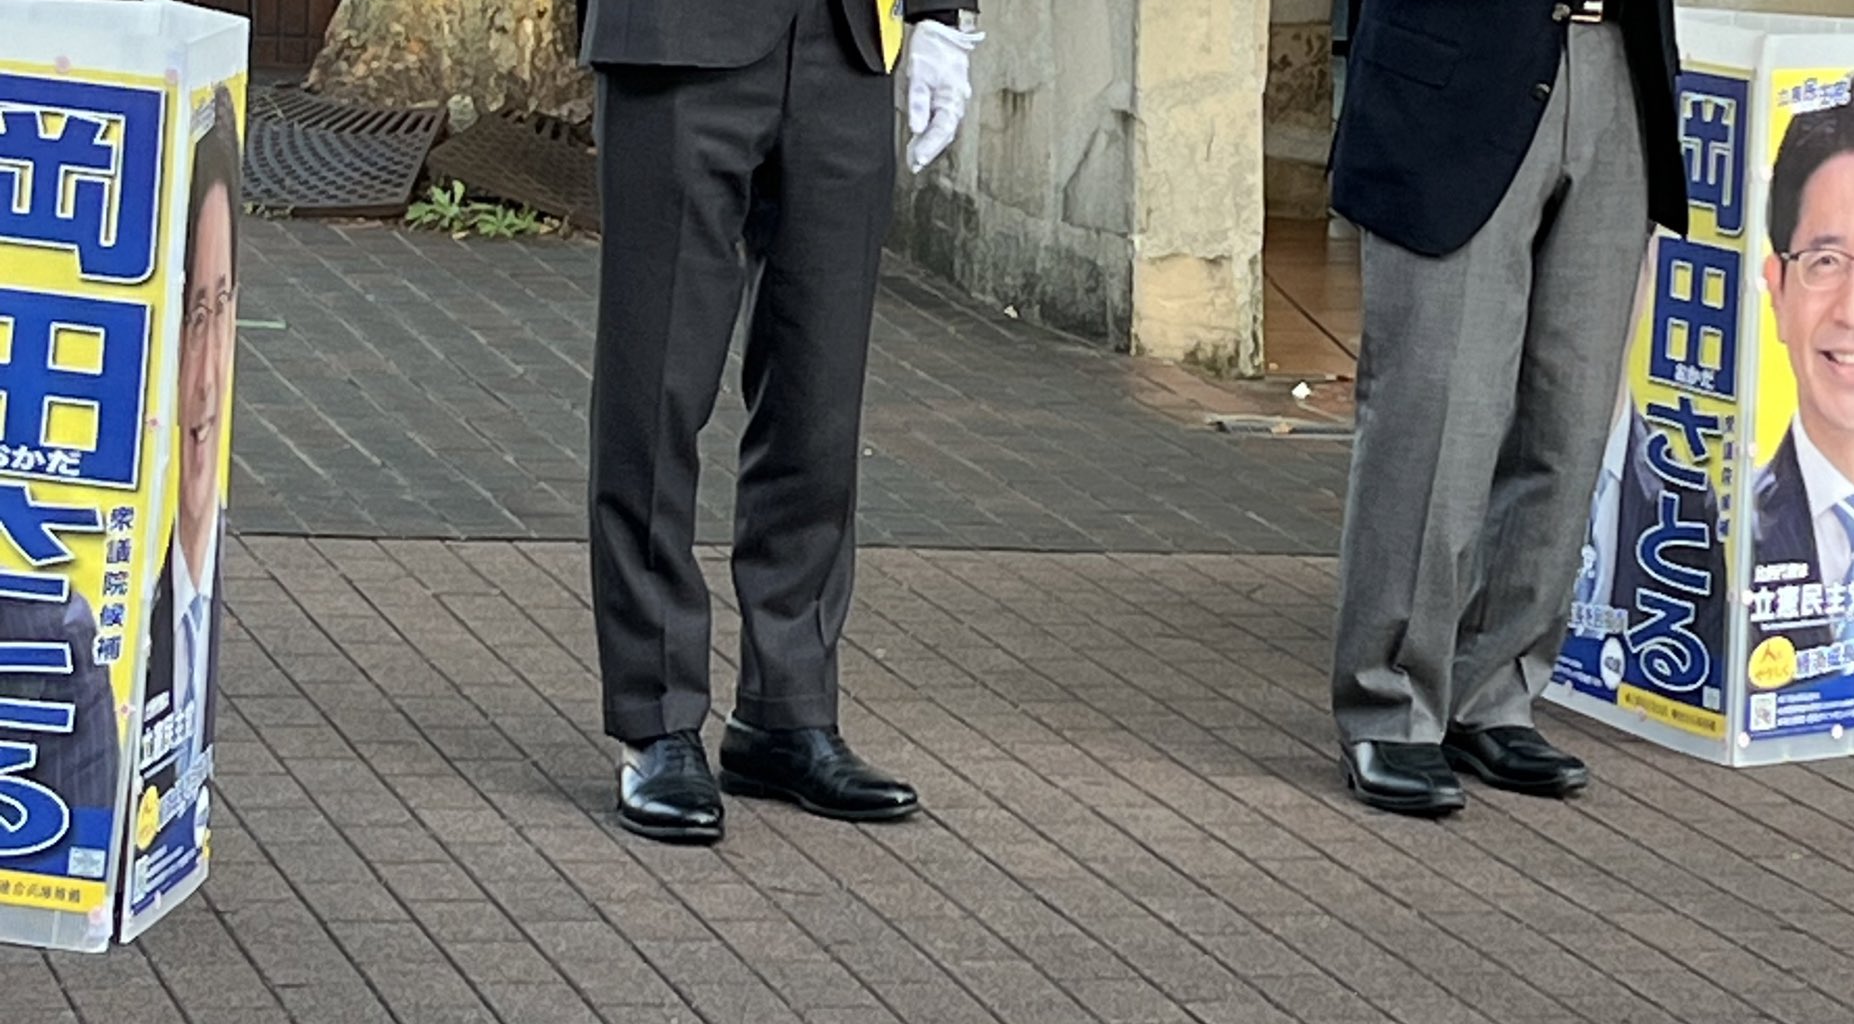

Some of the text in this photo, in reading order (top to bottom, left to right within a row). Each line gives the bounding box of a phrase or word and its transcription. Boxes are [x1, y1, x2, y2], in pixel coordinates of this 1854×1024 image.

[97, 506, 135, 663] 衆議院候補
